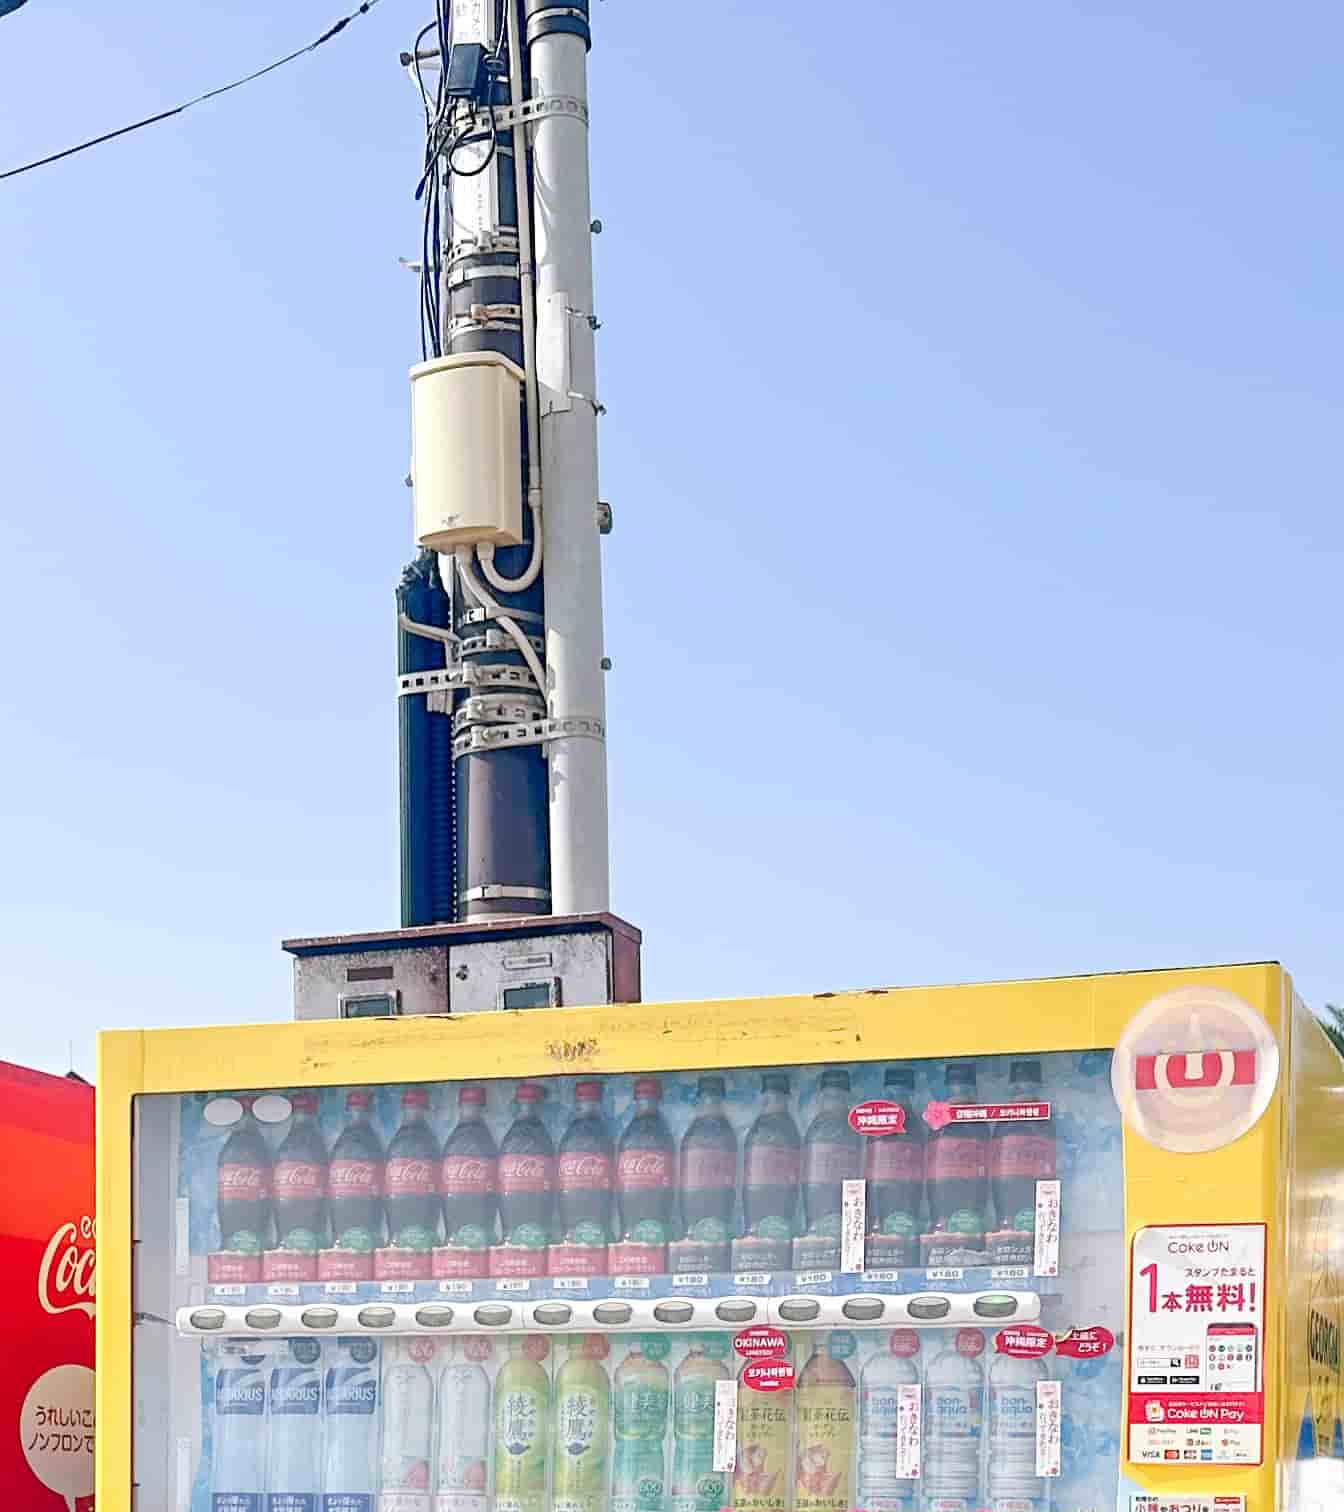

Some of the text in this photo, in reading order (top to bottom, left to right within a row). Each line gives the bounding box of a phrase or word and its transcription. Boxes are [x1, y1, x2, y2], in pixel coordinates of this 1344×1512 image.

[1167, 1241, 1205, 1254] Coke
[34, 1405, 96, 1428] うれしいこ
[1167, 1408, 1199, 1419] Coke
[1220, 1408, 1244, 1421] Pay
